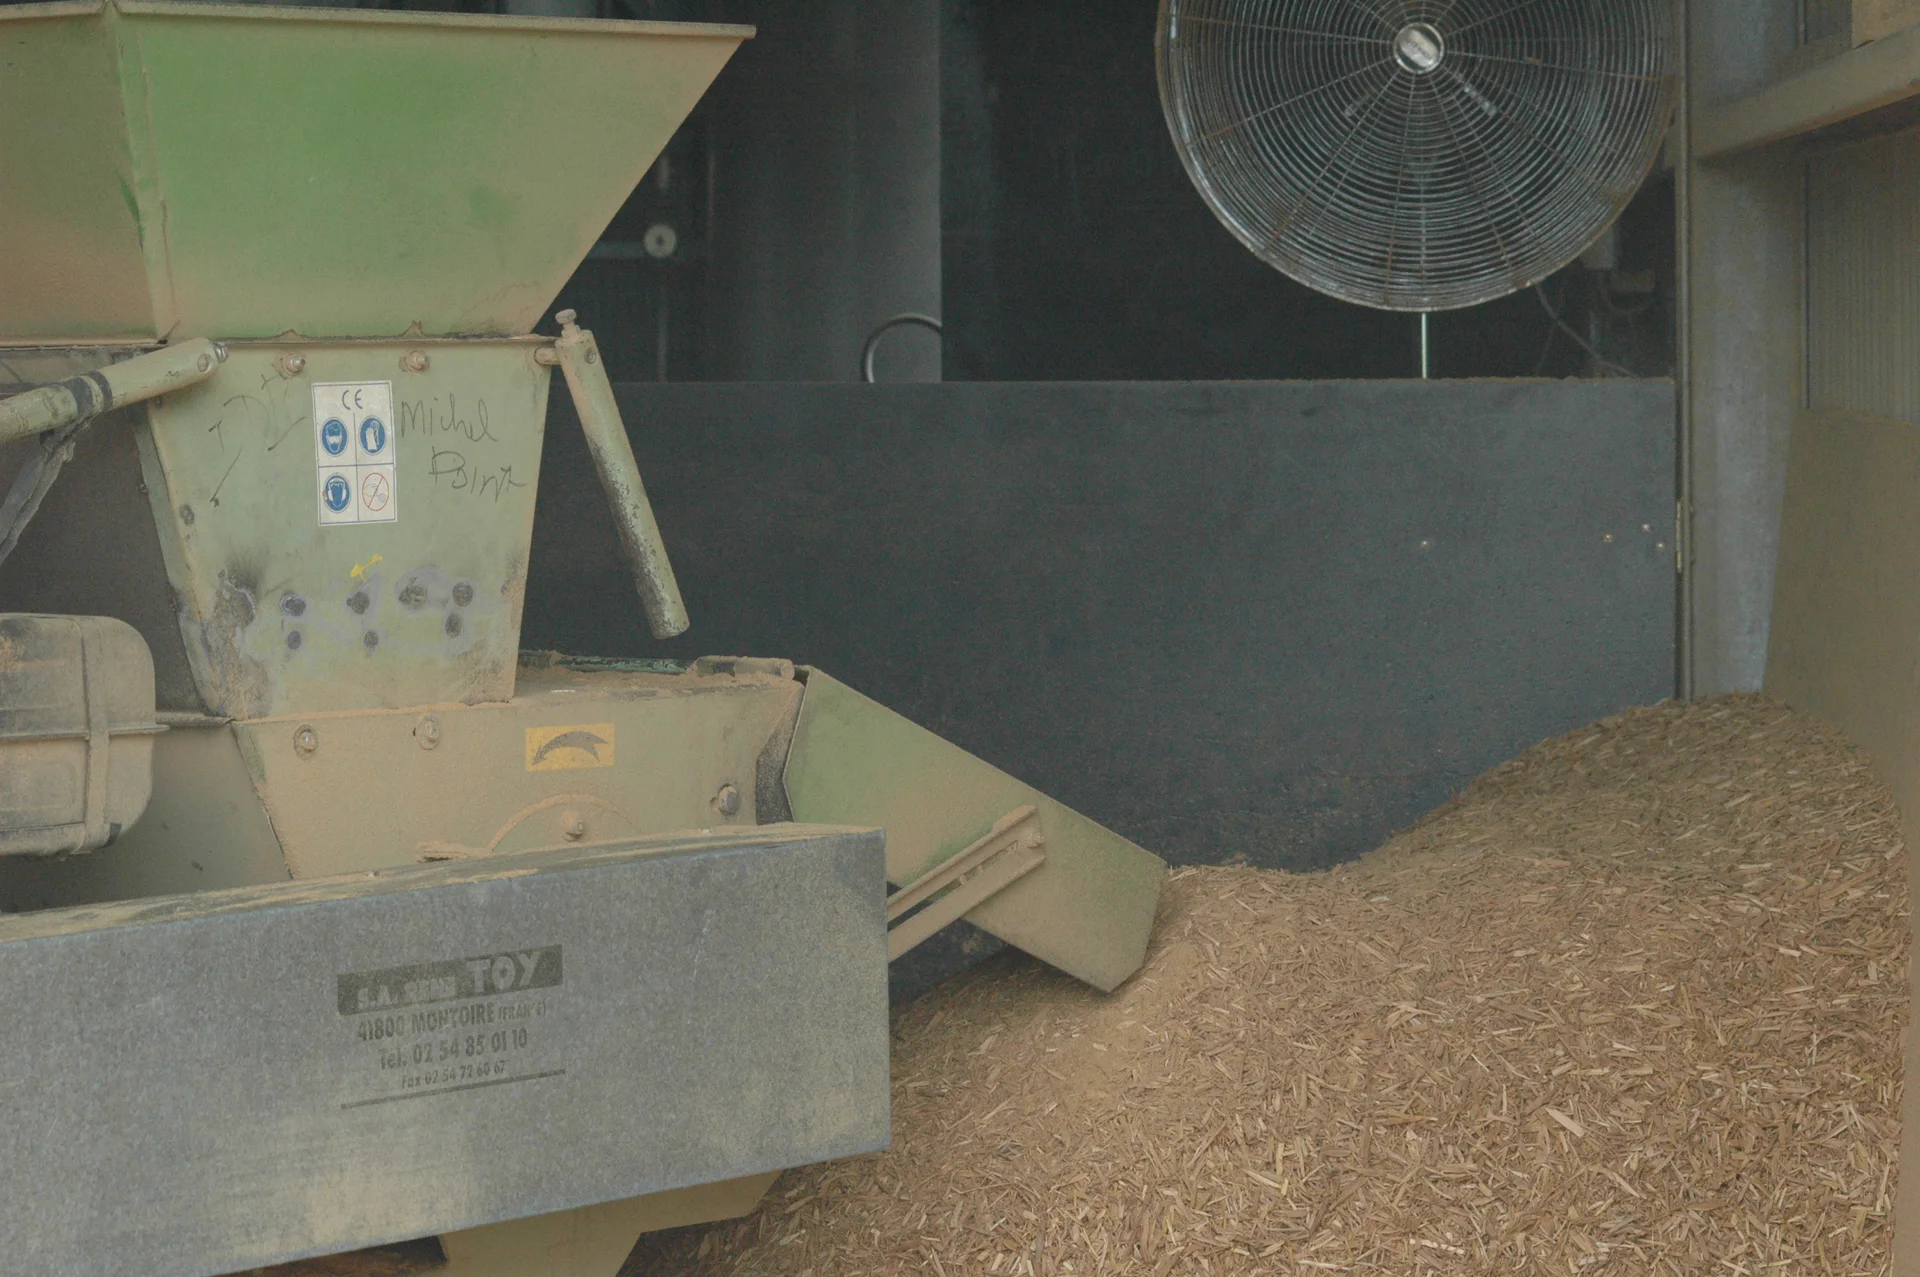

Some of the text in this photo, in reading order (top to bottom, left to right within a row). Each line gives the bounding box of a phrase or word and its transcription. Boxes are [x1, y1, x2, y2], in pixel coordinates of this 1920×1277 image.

[465, 951, 542, 993] TOY
[357, 1014, 406, 1042] 41800
[412, 1002, 495, 1034] MONTOIRE
[412, 1042, 433, 1065] 02
[439, 1037, 459, 1061] 54
[465, 1034, 485, 1057] 85
[491, 1030, 507, 1053] 01
[512, 1027, 528, 1050] 10
[425, 1070, 439, 1085] 02
[460, 1064, 474, 1079] 72
[494, 1059, 506, 1074] 67
